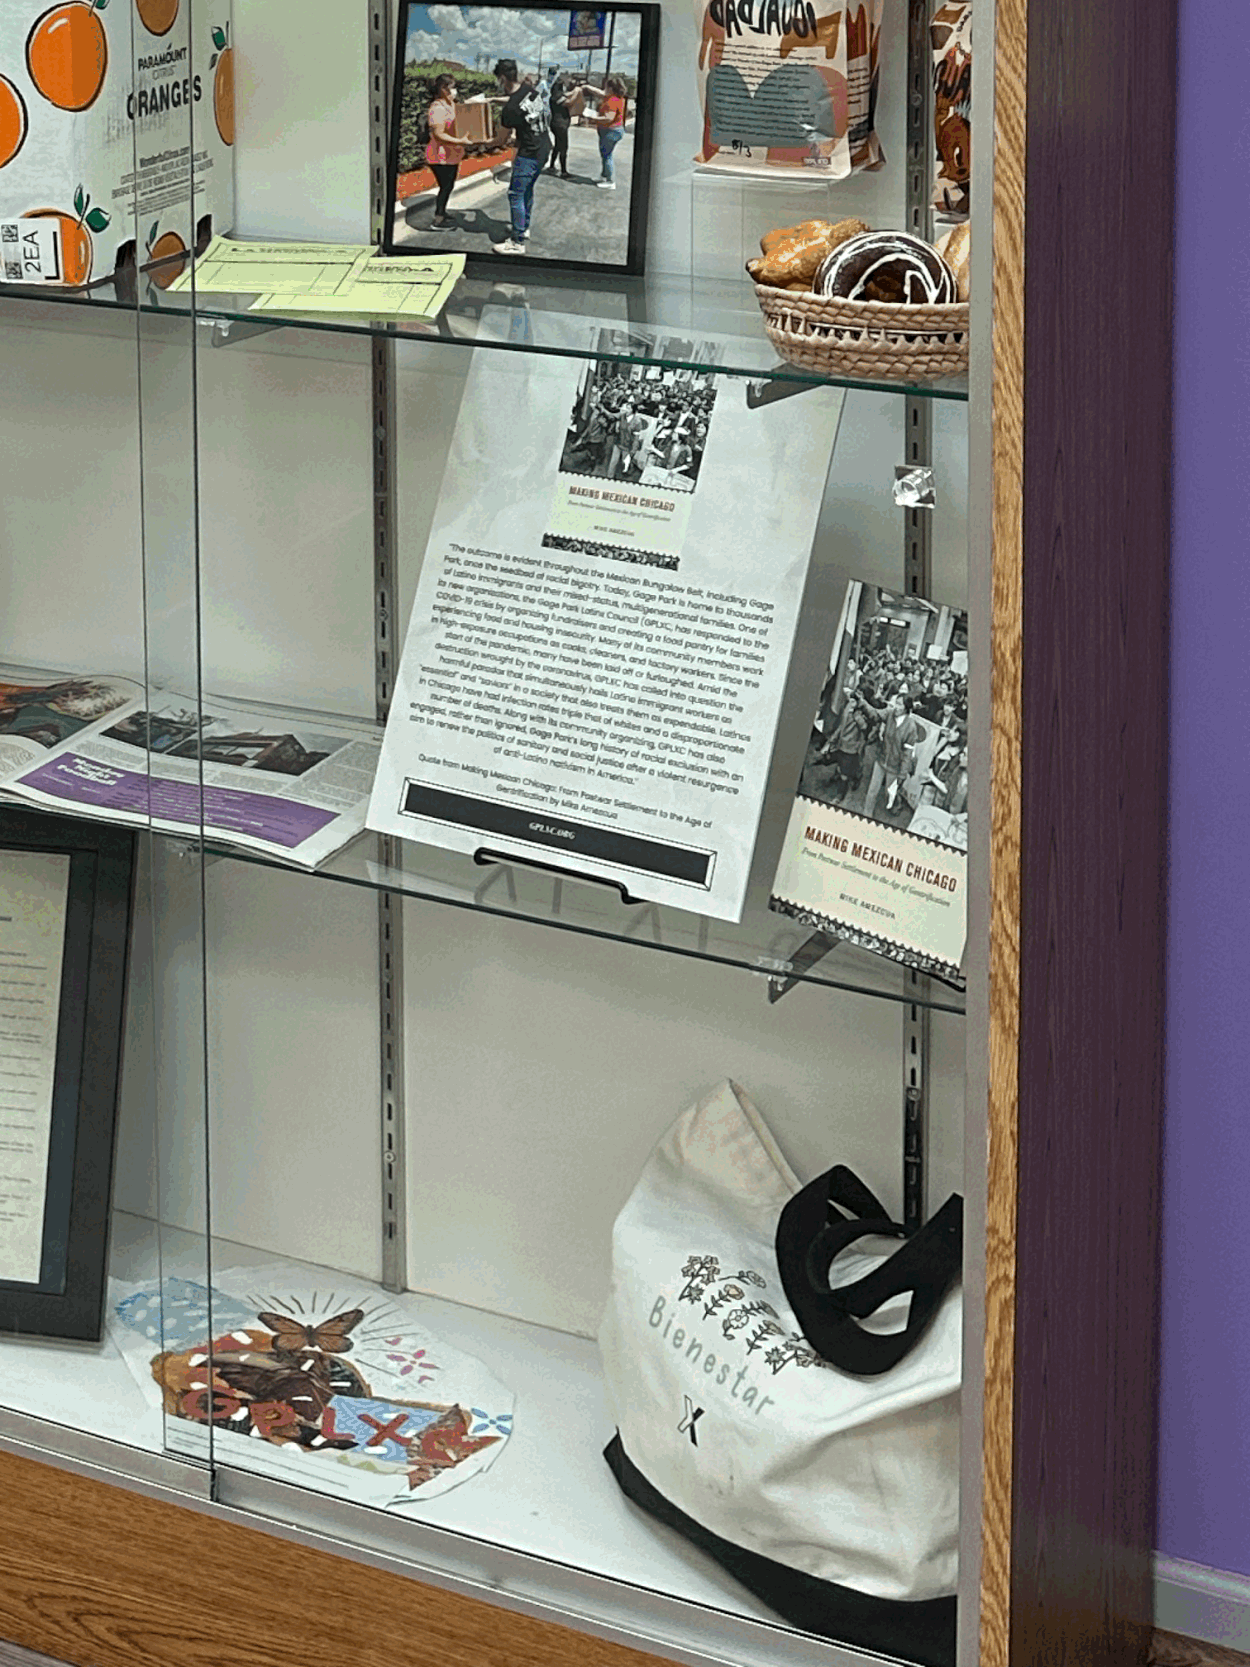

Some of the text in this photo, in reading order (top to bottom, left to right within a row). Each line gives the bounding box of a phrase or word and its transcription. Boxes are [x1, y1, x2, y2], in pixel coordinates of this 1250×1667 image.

[138, 46, 187, 72] PARAMOUNT
[127, 75, 202, 121] ORANGES
[22, 230, 42, 273] 2EA
[569, 485, 600, 500] MAKING
[601, 491, 638, 506] MEXICAN
[639, 497, 676, 513] CHICAGO
[804, 825, 958, 893] MAKING MEXICAN CHICAGO
[839, 892, 896, 920] MIKE AMEZCUA
[649, 1295, 775, 1416] Bienestar
